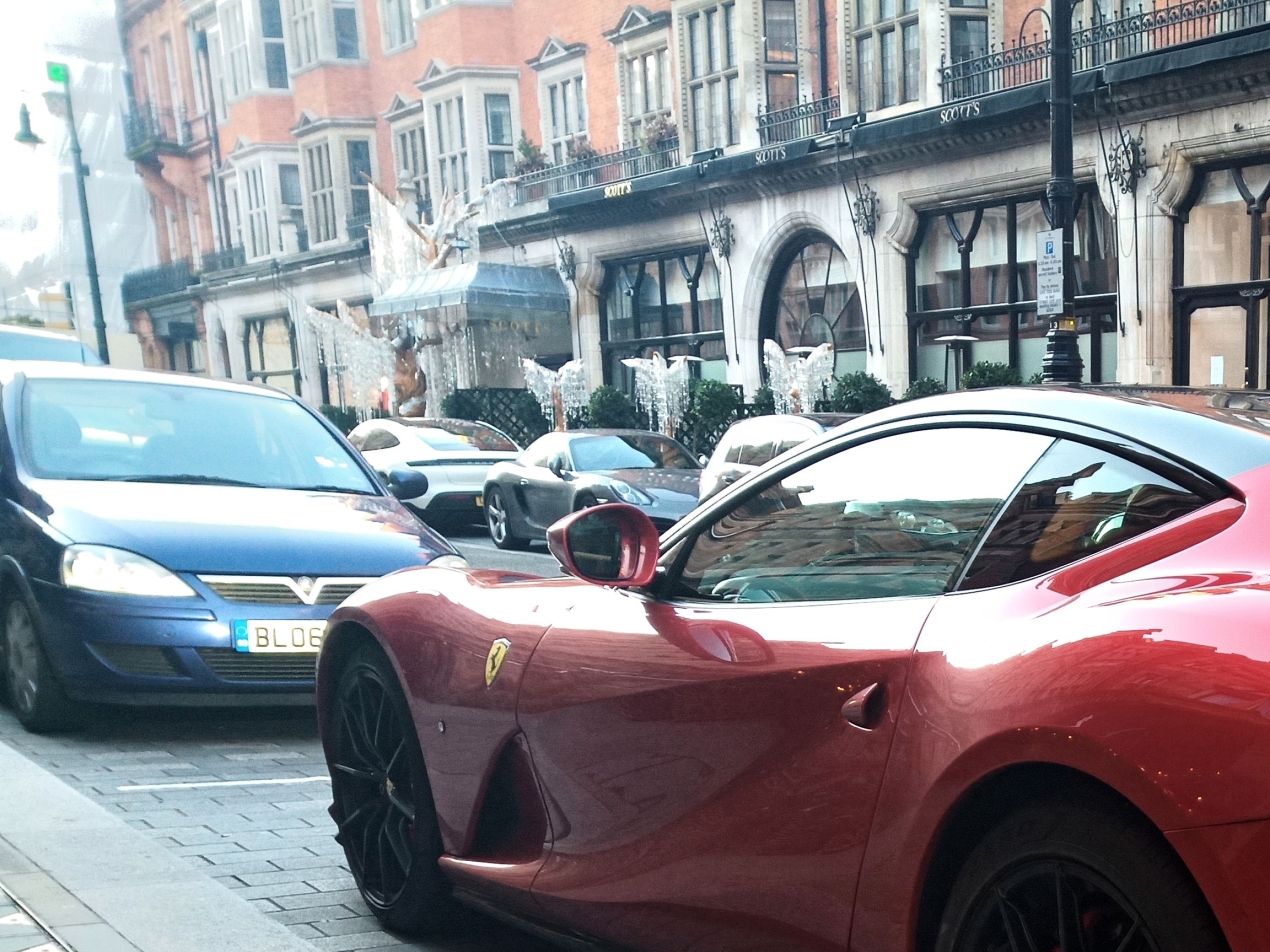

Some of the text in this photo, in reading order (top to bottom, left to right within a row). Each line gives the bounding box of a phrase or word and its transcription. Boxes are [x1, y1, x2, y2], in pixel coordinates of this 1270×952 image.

[940, 101, 980, 124] SCOTT'S
[755, 146, 787, 165] SCOTT'S
[604, 181, 632, 198] SCOTT'S
